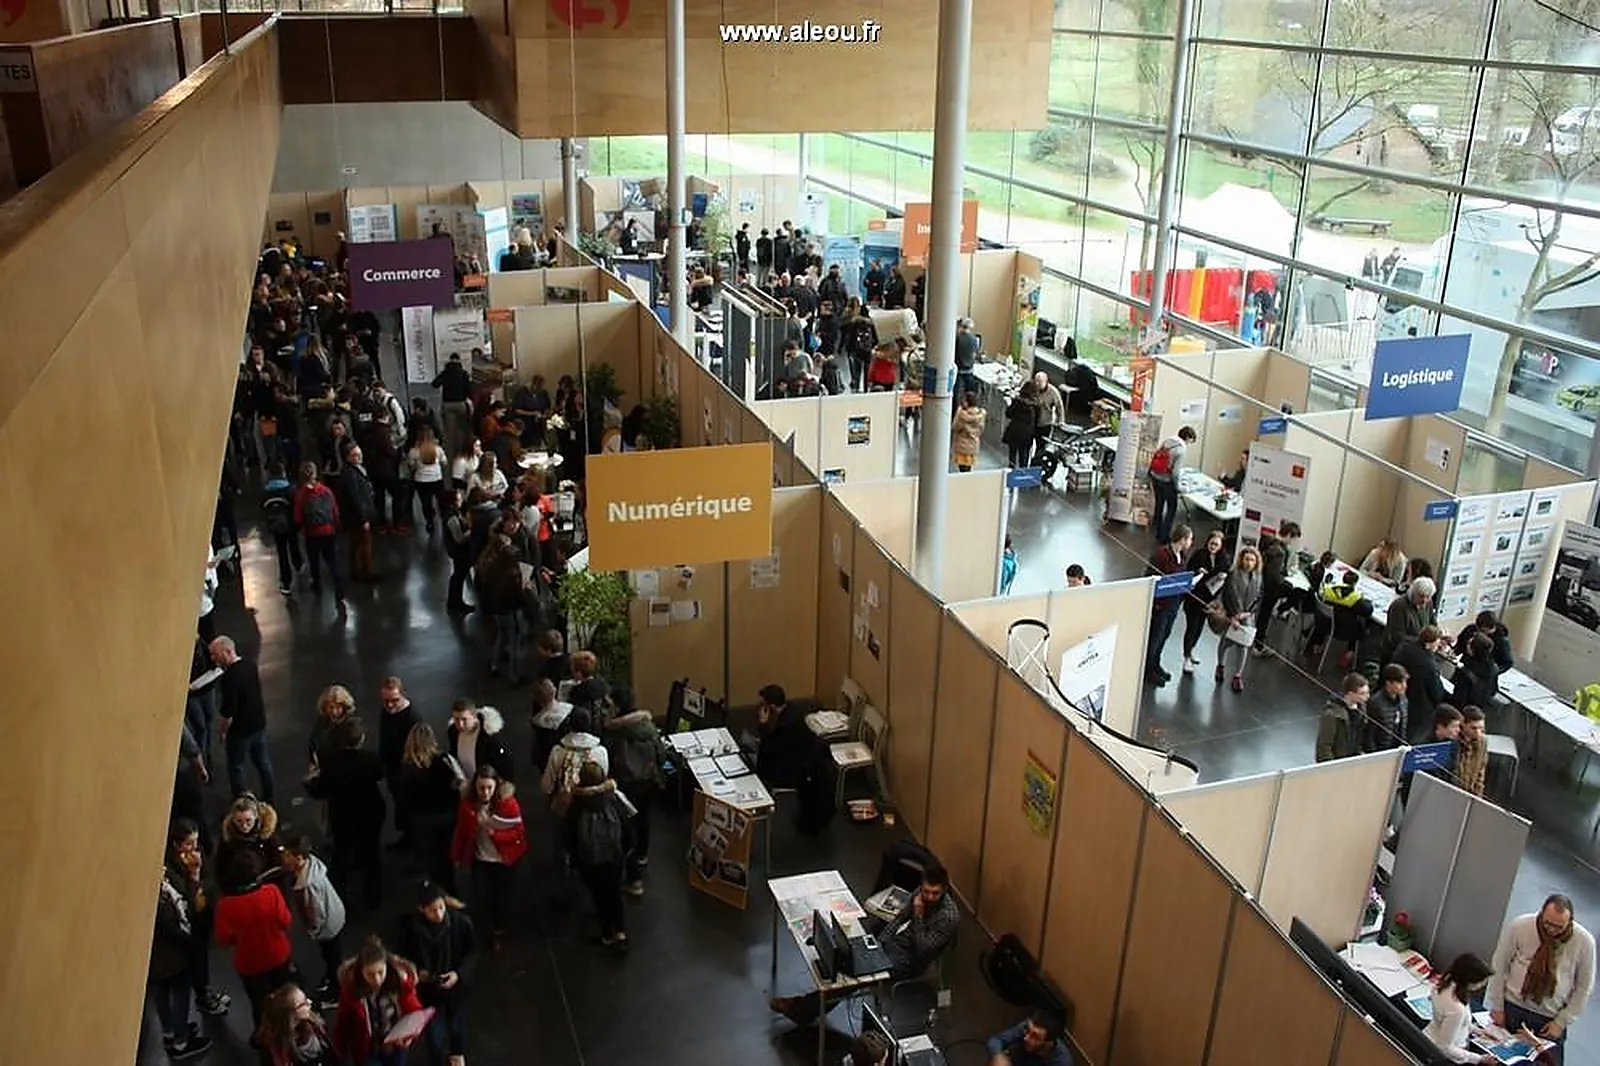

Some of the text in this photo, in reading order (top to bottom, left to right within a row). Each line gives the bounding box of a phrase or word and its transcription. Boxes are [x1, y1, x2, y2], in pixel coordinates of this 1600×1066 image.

[362, 267, 442, 283] Commerce
[1382, 367, 1455, 390] Logistique
[607, 494, 754, 523] Numérique
